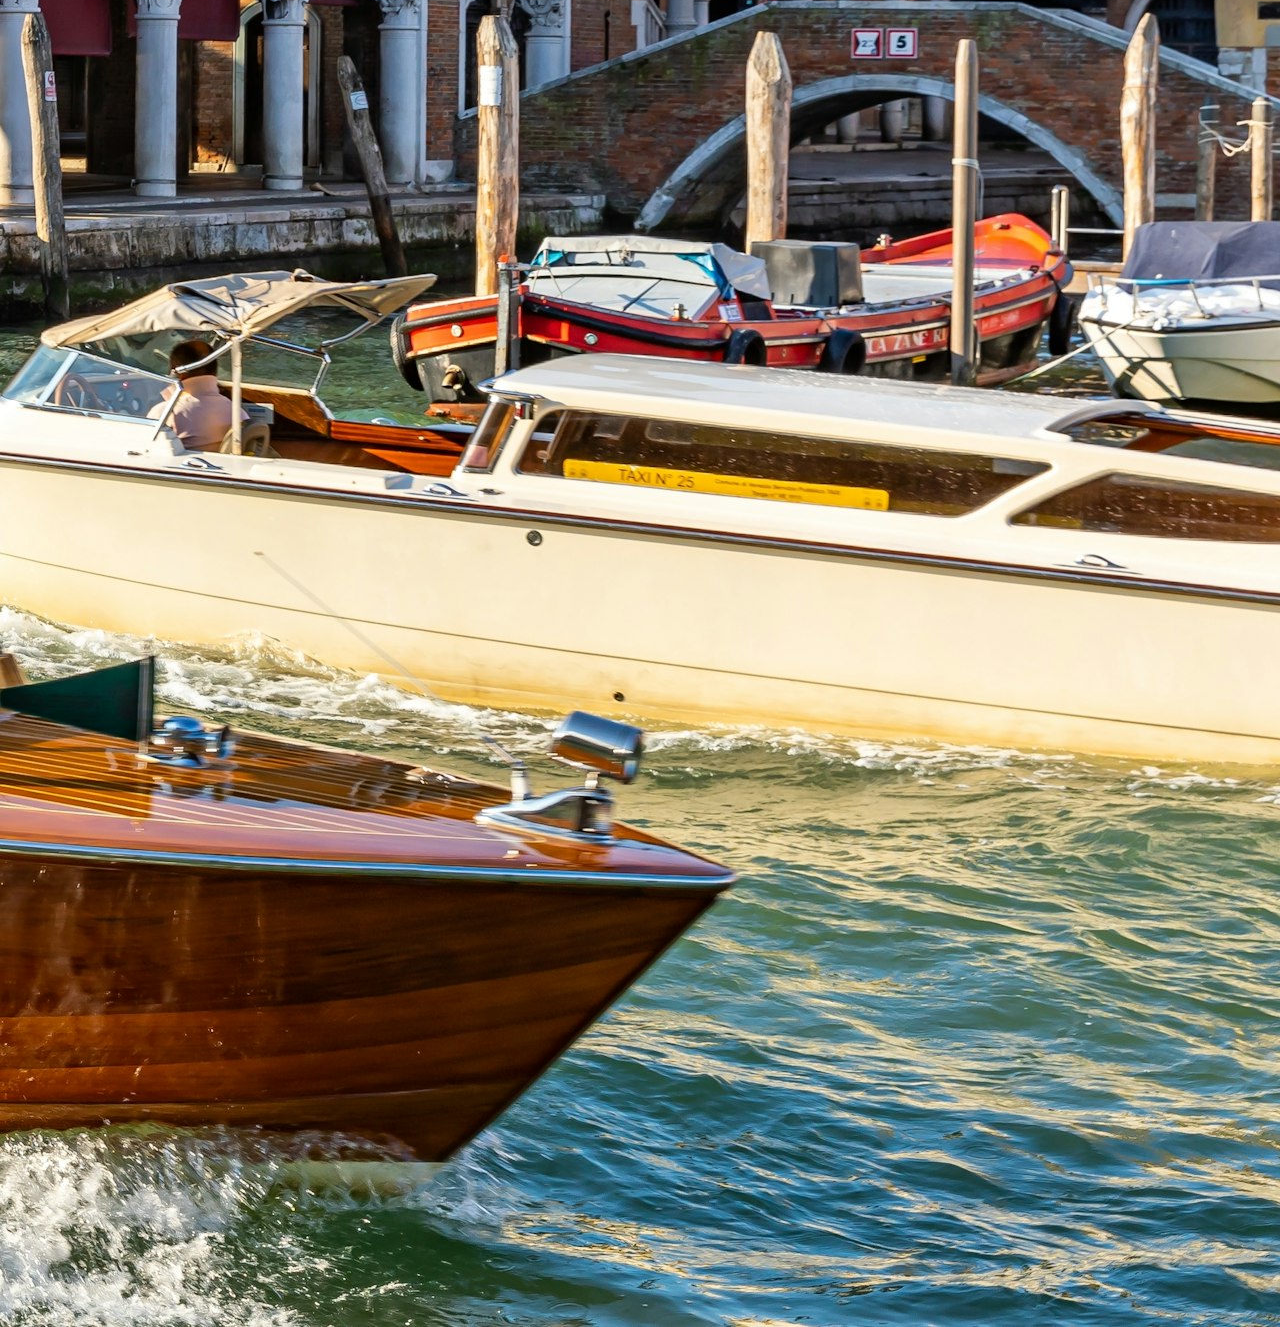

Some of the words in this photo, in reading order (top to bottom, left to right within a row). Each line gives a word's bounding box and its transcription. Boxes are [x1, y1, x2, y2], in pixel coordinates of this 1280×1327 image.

[896, 35, 907, 49] 5
[618, 469, 652, 484] TAXI
[677, 475, 695, 488] 25
